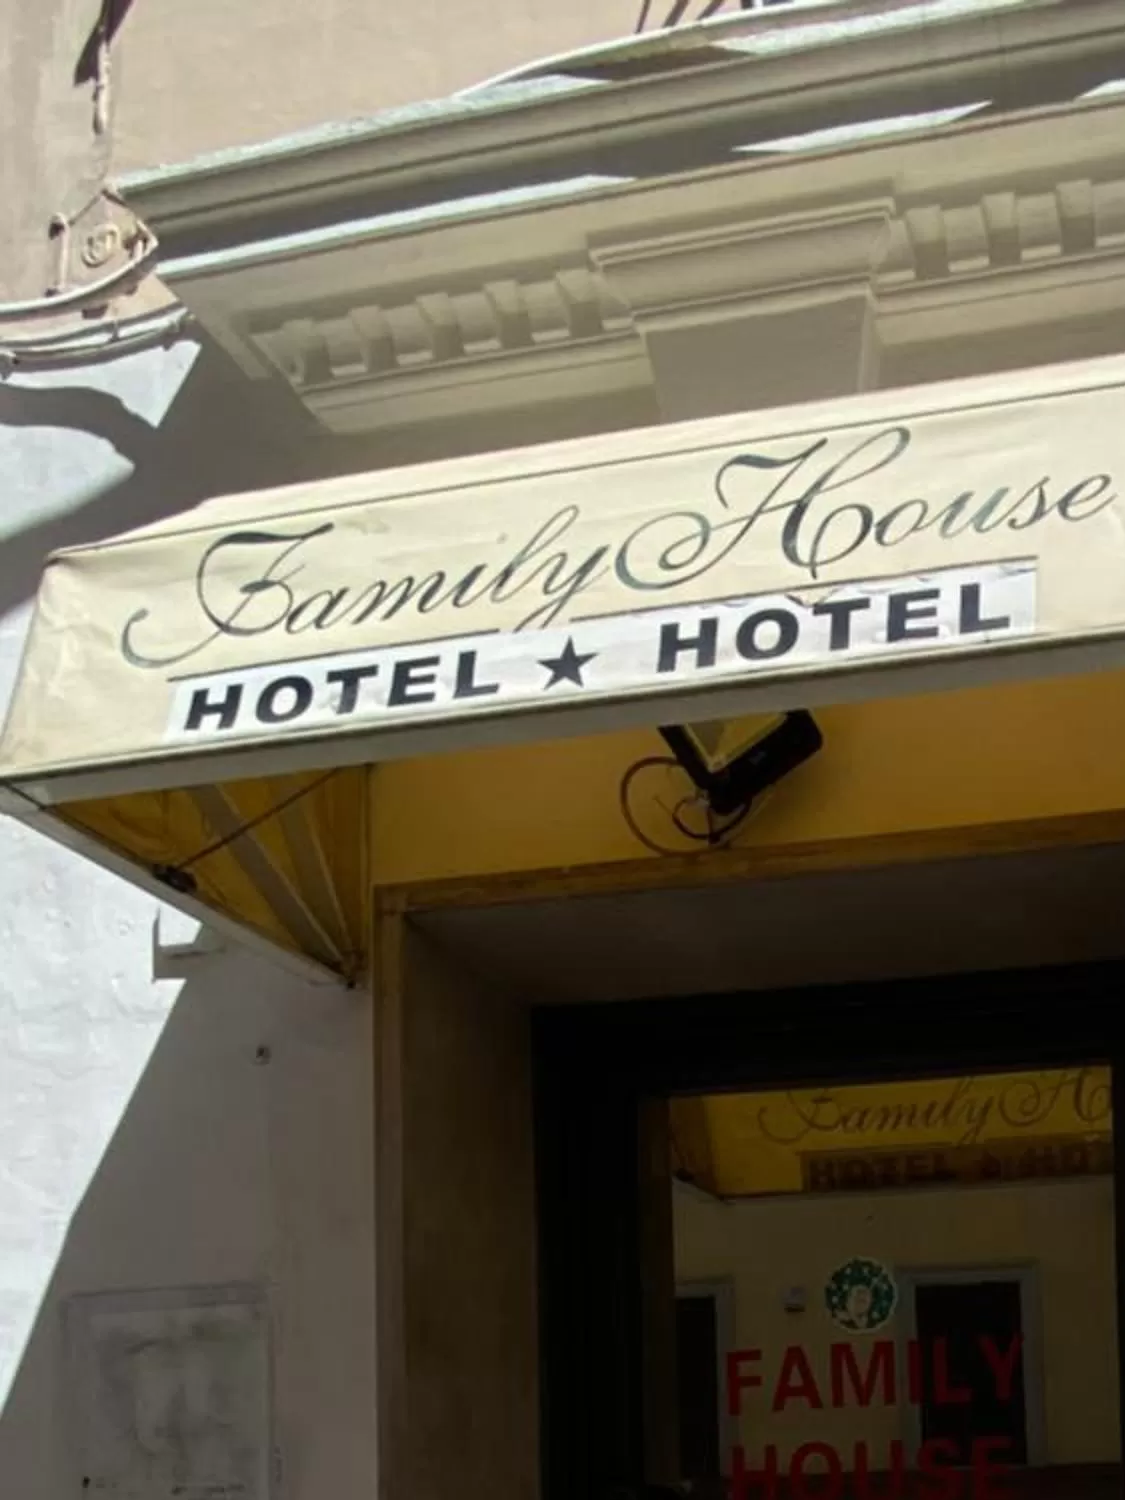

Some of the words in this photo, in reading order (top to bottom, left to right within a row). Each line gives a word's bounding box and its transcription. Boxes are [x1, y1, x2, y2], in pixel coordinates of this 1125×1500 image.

[120, 504, 610, 669] Family
[614, 426, 1119, 591] House
[183, 649, 500, 732] HOTEL
[656, 582, 1011, 673] HOTEL
[723, 1332, 1024, 1417] FAMILY
